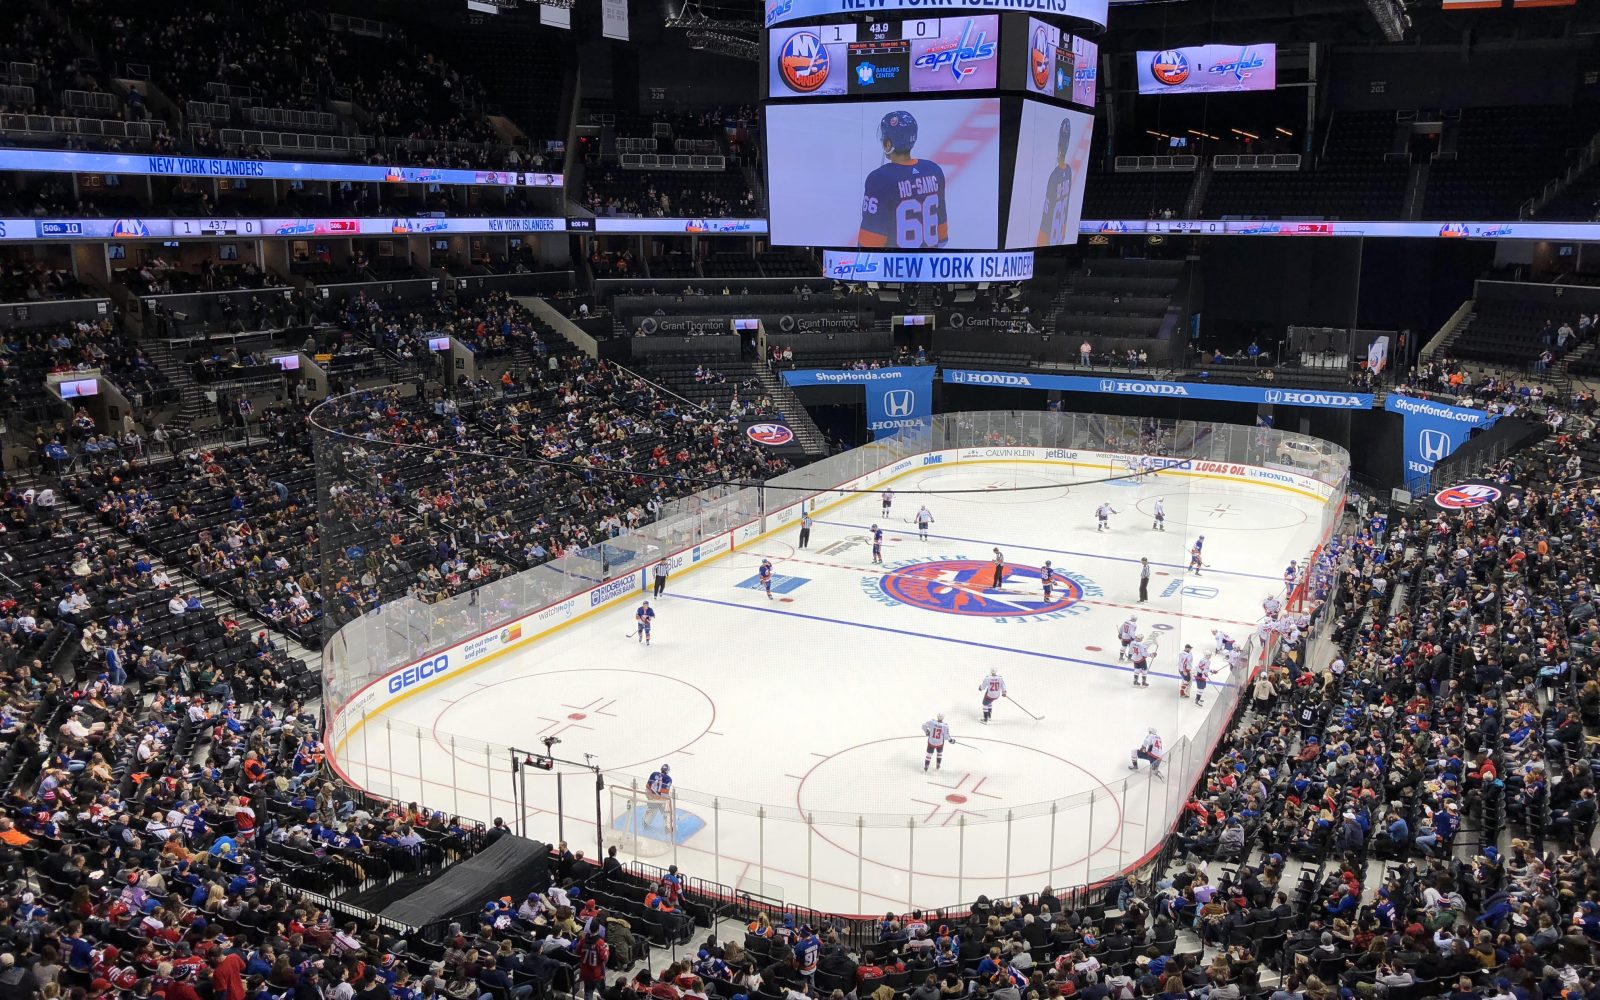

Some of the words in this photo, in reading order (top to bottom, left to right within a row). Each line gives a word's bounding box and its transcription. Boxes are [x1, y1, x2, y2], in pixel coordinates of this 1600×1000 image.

[834, 26, 842, 41] 1
[916, 22, 926, 37] 0
[150, 157, 174, 173] NEW
[178, 159, 207, 175] YORK
[209, 161, 264, 176] ISLANDERS
[208, 220, 228, 230] 43.7
[245, 221, 253, 233] 0
[346, 222, 351, 230] 7
[488, 219, 503, 230] NEW
[504, 219, 521, 231] YORK
[522, 219, 554, 231] ISLANDERS
[896, 193, 939, 248] 66
[1155, 223, 1161, 231] 1
[1176, 222, 1194, 230] 43.7
[65, 223, 78, 233] 10
[184, 222, 192, 233] 1
[1209, 223, 1216, 232] 0
[883, 256, 923, 278] NEW
[929, 256, 974, 279] YORK
[981, 255, 1033, 278] ISLANDERS
[660, 320, 685, 330] Grant
[685, 320, 724, 331] Thornton
[798, 318, 821, 328] Grant
[821, 318, 856, 328] Thornton
[967, 316, 989, 326] Grant
[990, 317, 1027, 327] Thornton
[815, 370, 902, 383] ShopHonda.com
[967, 373, 1032, 387] HONDA
[1116, 382, 1189, 396] HONDA
[1284, 392, 1363, 407] HONDA
[1395, 399, 1480, 423] ShopHonda.com
[872, 418, 925, 431] HONDA
[985, 449, 1011, 457] CALVIN
[1013, 449, 1035, 457] KLEIN
[1045, 448, 1078, 460] jetBlue
[895, 460, 912, 472] HONDA
[1195, 462, 1228, 474] LUCAS
[1230, 466, 1246, 476] OIL
[1259, 471, 1295, 484] HONDA
[882, 554, 968, 570] CENTER
[600, 574, 636, 594] RIDGEWOOD
[1053, 567, 1105, 598] BARCLAYS
[1159, 578, 1185, 598] HONDA
[601, 588, 623, 603] SAVINGS
[623, 582, 636, 594] BANK
[860, 575, 900, 607] BARCLAYS
[993, 605, 1091, 624] CENTER
[464, 643, 474, 652] Get
[474, 638, 484, 649] out
[484, 634, 499, 644] there
[464, 650, 475, 660] and
[388, 655, 449, 694] GEICO
[989, 681, 1000, 692] 20
[1301, 709, 1312, 721] 91
[932, 728, 943, 740] 13
[582, 948, 598, 967] 70
